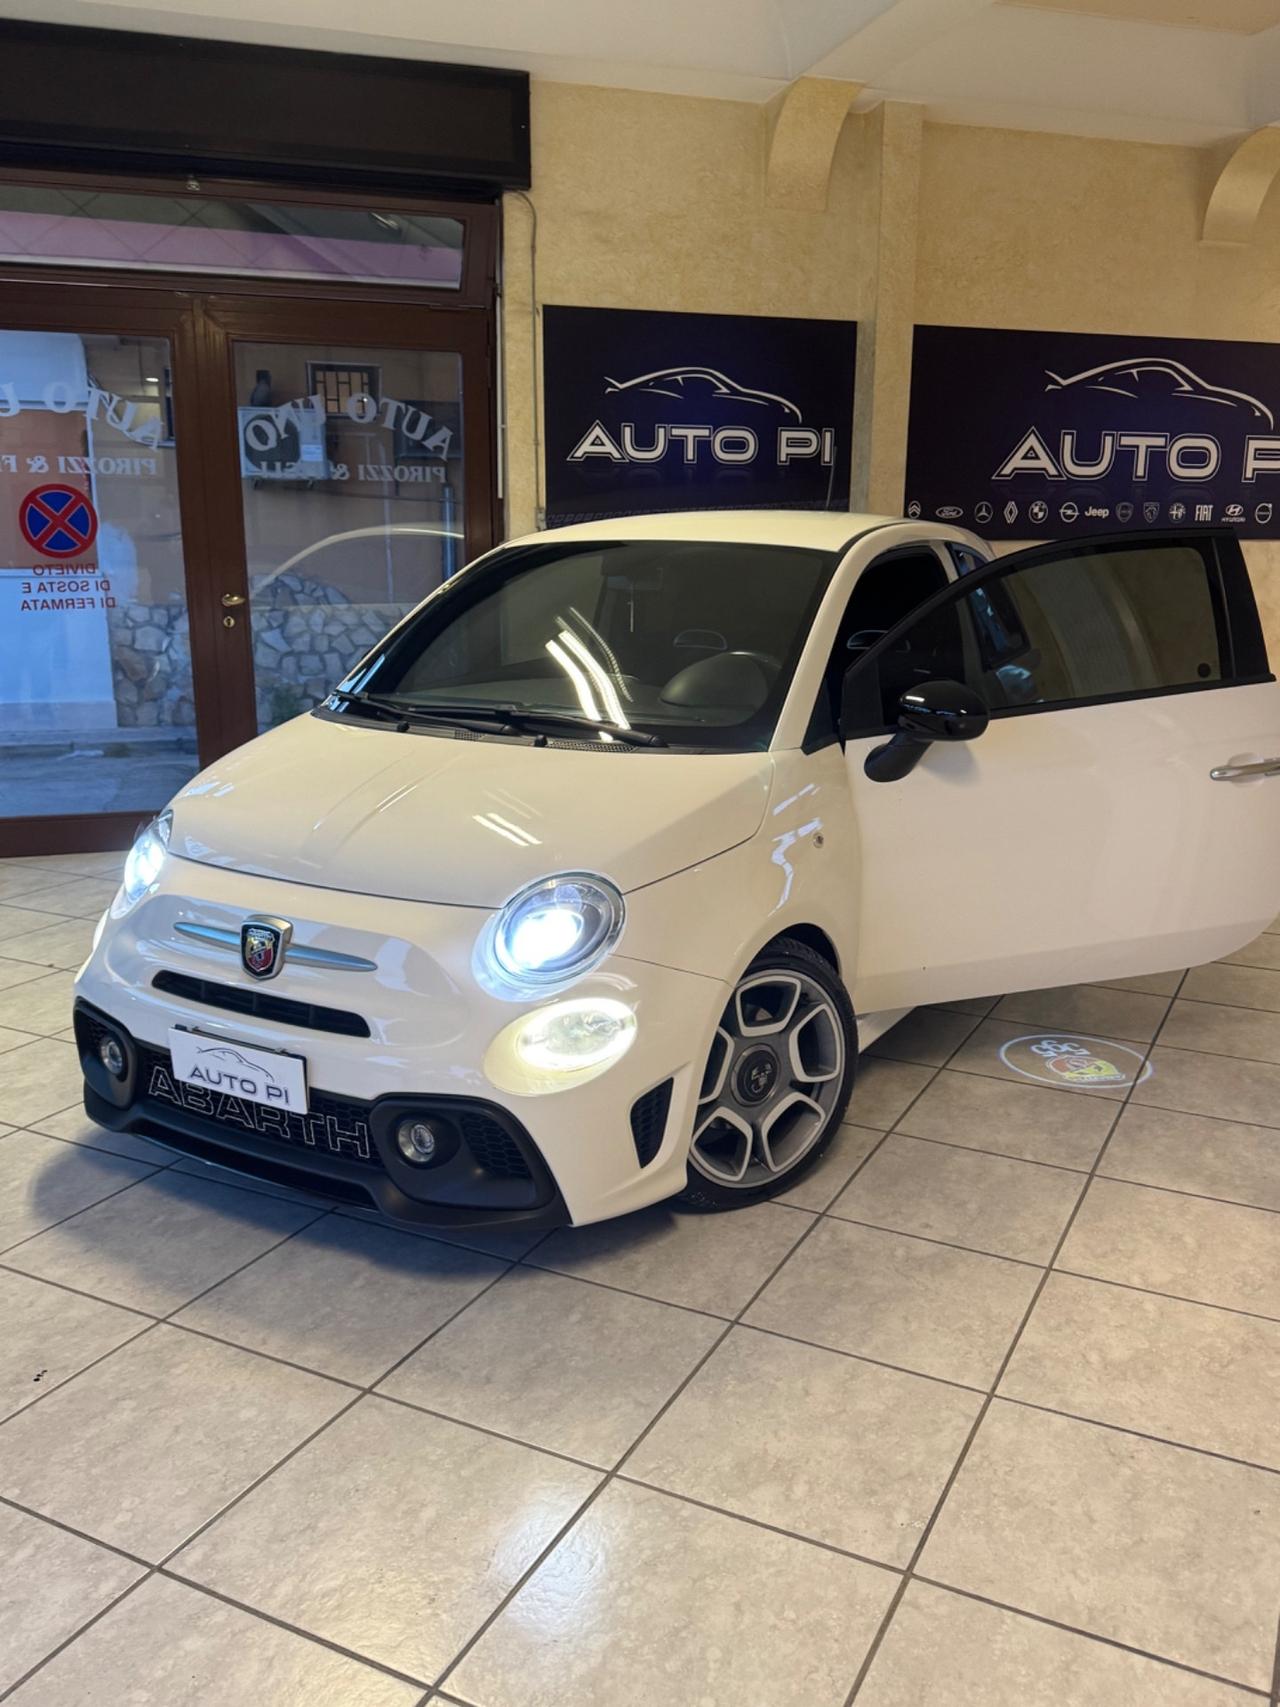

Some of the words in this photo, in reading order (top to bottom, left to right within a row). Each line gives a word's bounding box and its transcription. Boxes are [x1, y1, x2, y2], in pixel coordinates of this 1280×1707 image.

[566, 419, 759, 465] AUTO
[776, 427, 835, 466] PI
[991, 426, 1222, 482] AUTO
[1241, 434, 1280, 483] P
[1084, 505, 1110, 519] Jeep
[1194, 504, 1214, 521] FIAT
[190, 1064, 257, 1096] AUTO
[266, 1084, 290, 1106] PI
[148, 1065, 370, 1159] ABARTH
